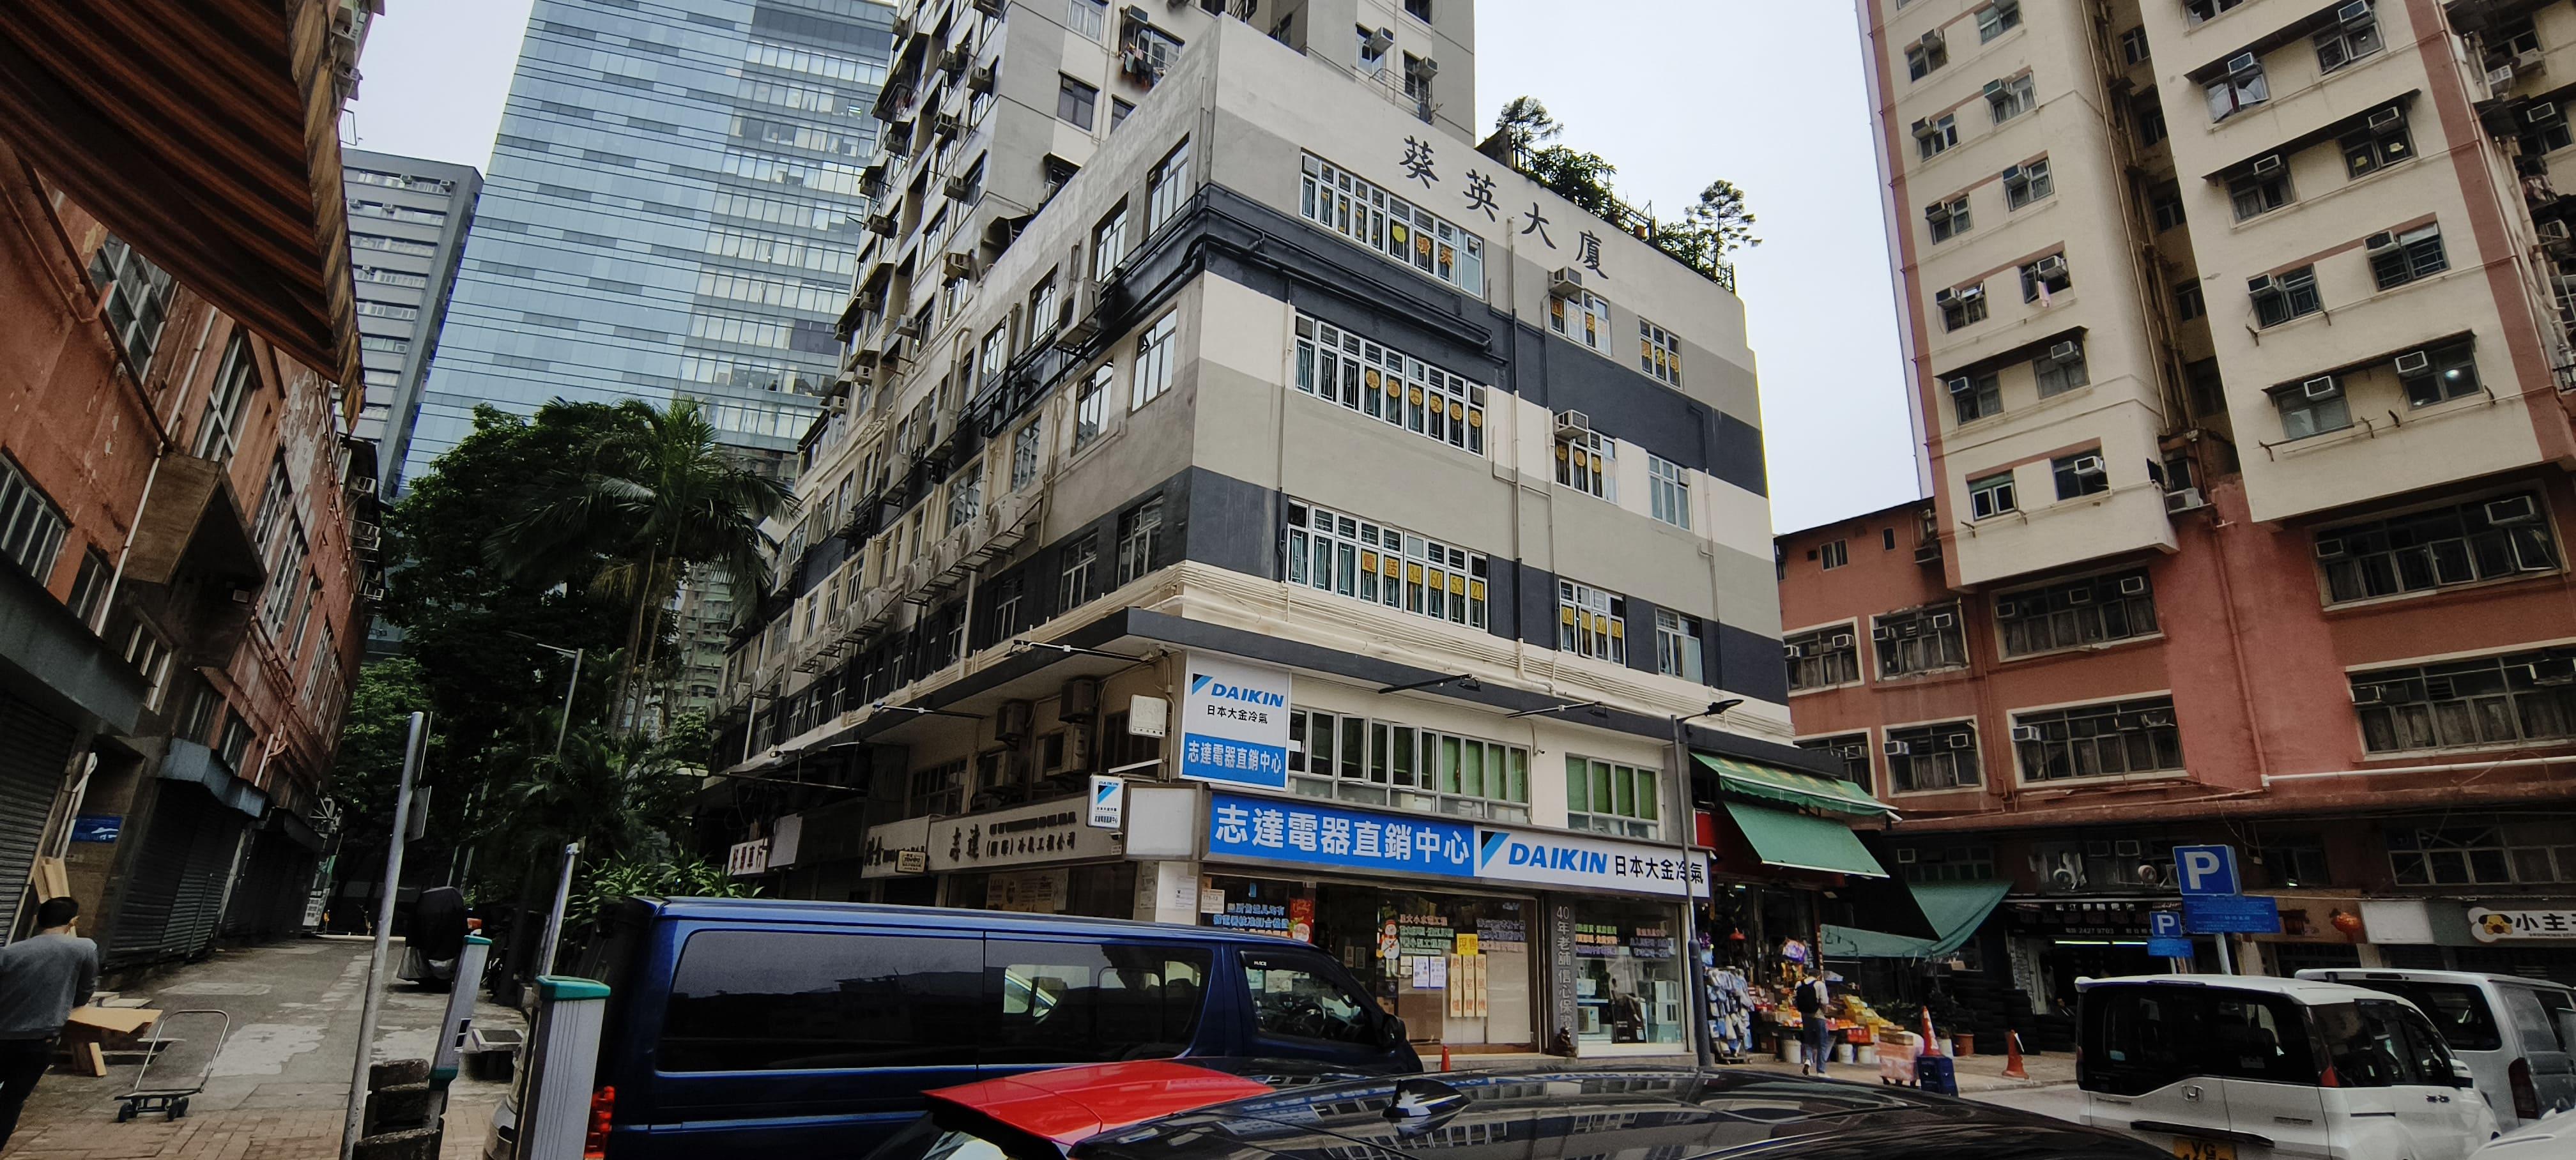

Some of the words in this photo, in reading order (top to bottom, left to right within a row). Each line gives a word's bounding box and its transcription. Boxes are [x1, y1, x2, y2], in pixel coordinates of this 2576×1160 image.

[1399, 135, 1609, 279] 葵英大廈
[1211, 683, 1284, 707] DAIKIN
[1207, 705, 1268, 724] 日本大金冷氣
[1188, 740, 1282, 774] 志達電器直銷中心
[1215, 804, 1469, 864] 志達電器直銷中心
[1508, 843, 1608, 874] DAIKIN
[1615, 855, 1704, 884] 日本大金冷氣
[2184, 851, 2220, 890] P
[2157, 915, 2175, 935] P
